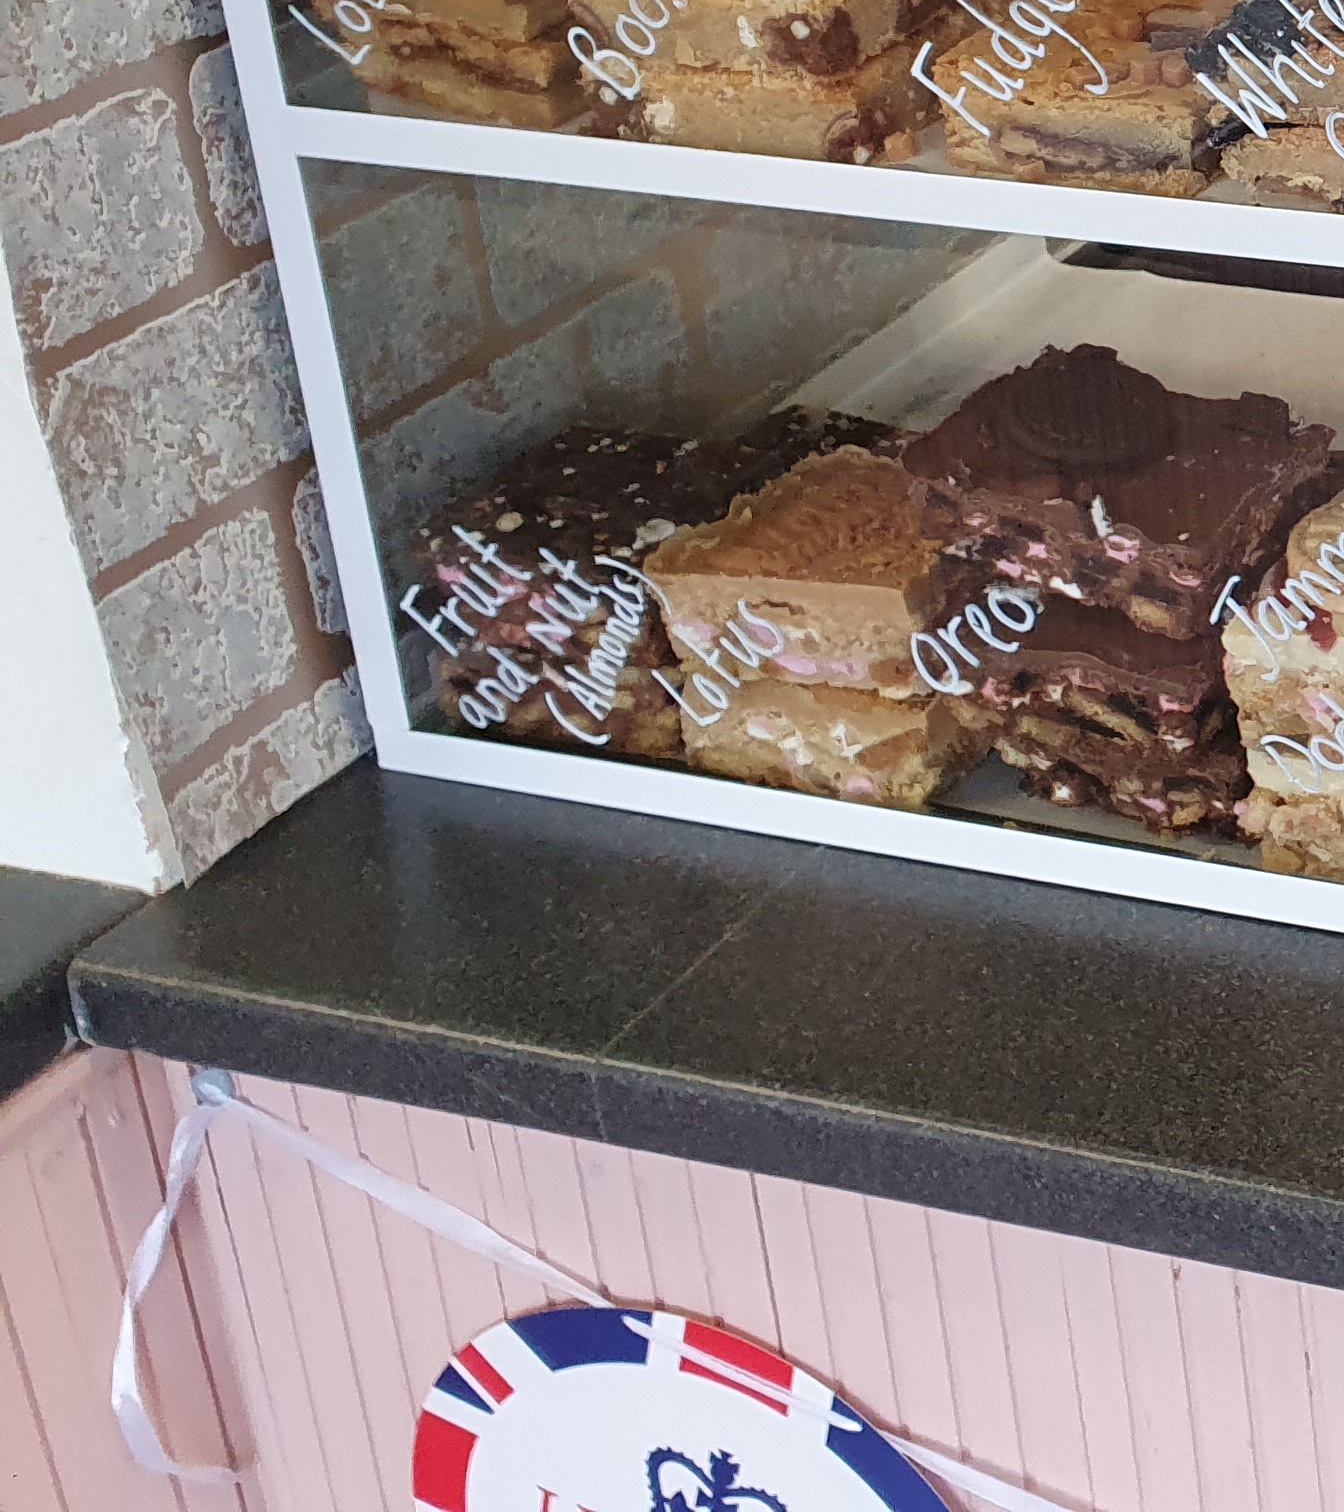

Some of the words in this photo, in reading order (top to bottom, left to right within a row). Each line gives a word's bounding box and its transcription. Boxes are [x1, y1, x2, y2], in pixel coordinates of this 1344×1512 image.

[400, 524, 533, 657] Fruit
[458, 645, 540, 729] and
[525, 547, 600, 655] Nut
[910, 586, 1039, 696] Oreo
[652, 598, 784, 728] Lotus
